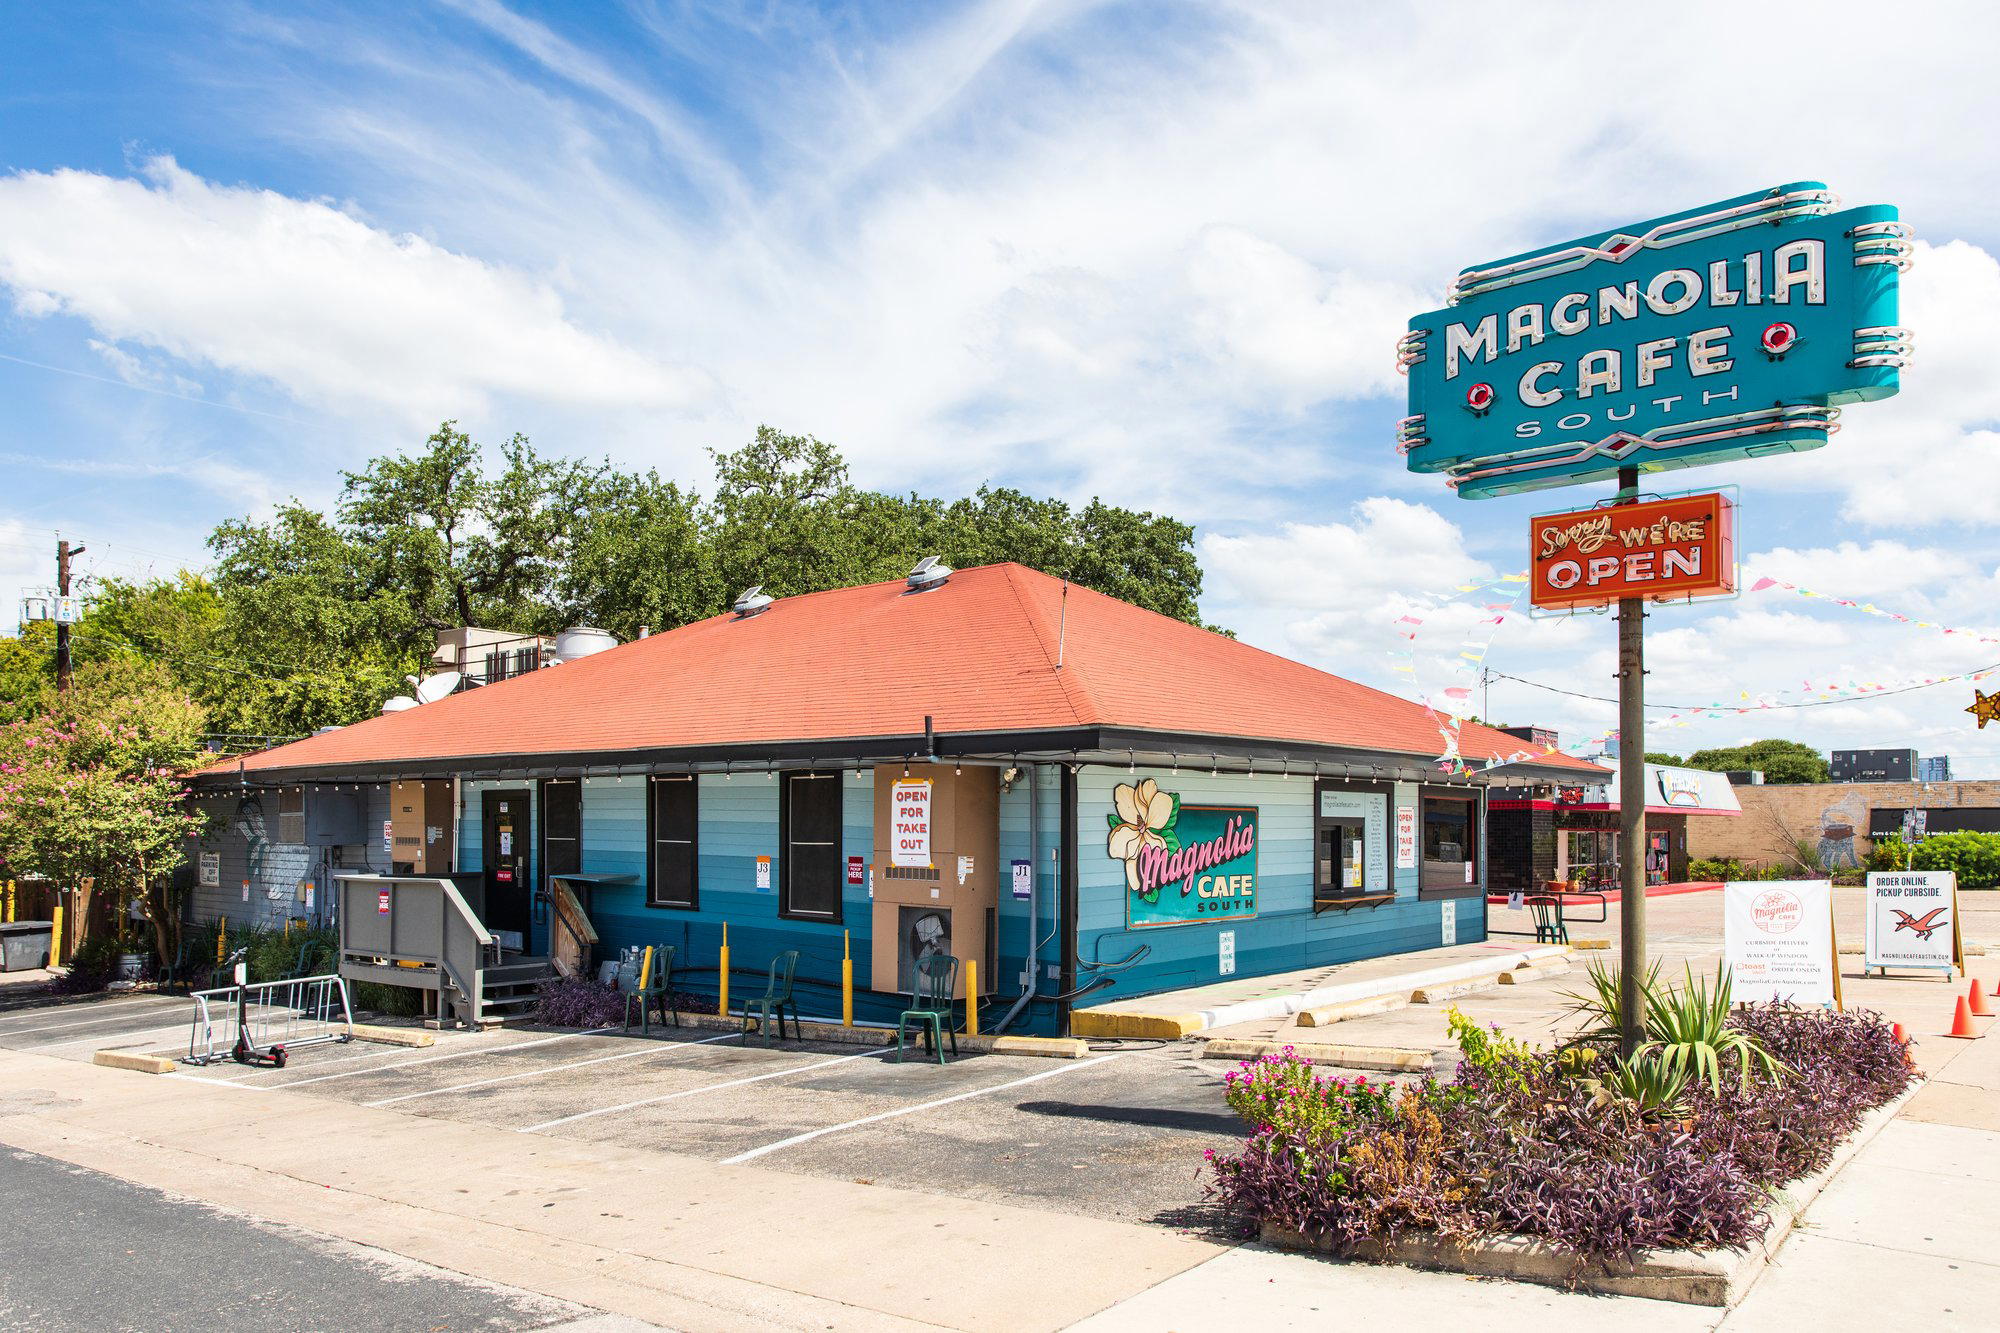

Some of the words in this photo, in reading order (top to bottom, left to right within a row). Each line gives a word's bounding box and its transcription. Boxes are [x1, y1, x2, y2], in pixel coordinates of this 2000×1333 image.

[1444, 239, 1827, 381] MAGNOLIA
[1517, 326, 1734, 408] CAFE
[1514, 385, 1739, 439] SOUTH
[1541, 515, 1618, 559] Sorry
[1619, 515, 1706, 549] WE'RE
[1546, 546, 1702, 590] OPEN
[896, 791, 927, 802] OPEN
[900, 807, 923, 817] FOR
[1398, 814, 1412, 822] OPEN
[896, 823, 927, 834] TAKE
[1401, 825, 1411, 833] FOR
[900, 839, 924, 849] OUT
[1399, 837, 1412, 845] TAKE
[1138, 815, 1254, 893] Magnolia
[1400, 848, 1411, 856] OUT
[757, 863, 769, 873] J3
[1016, 865, 1028, 876] J1
[1876, 877, 1899, 886] ORDER
[1901, 876, 1929, 886] ONLINE.
[1197, 875, 1253, 899] CAFE
[1876, 888, 1902, 897] PICKUP
[1904, 887, 1942, 897] CURBSIDE.
[1197, 900, 1253, 912] SOUTH
[1754, 902, 1798, 920] Magnolia
